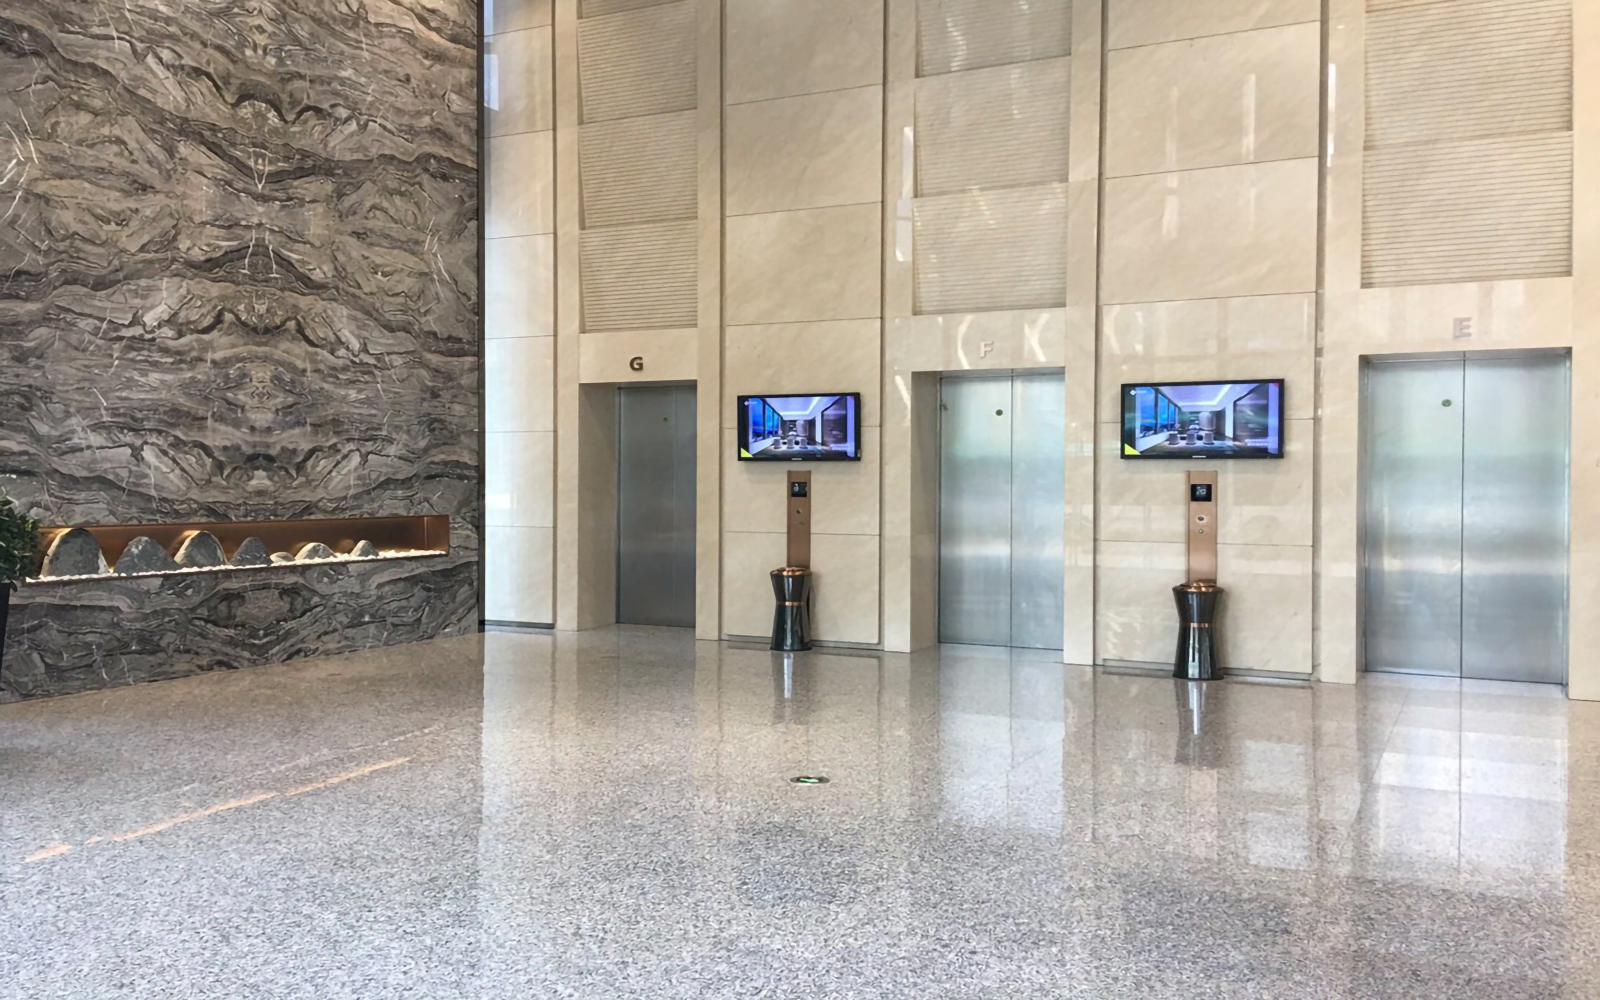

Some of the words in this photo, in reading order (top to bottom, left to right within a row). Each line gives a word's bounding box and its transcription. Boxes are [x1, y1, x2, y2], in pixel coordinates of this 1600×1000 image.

[1453, 317, 1472, 338] E
[980, 341, 994, 359] F
[629, 356, 644, 371] G
